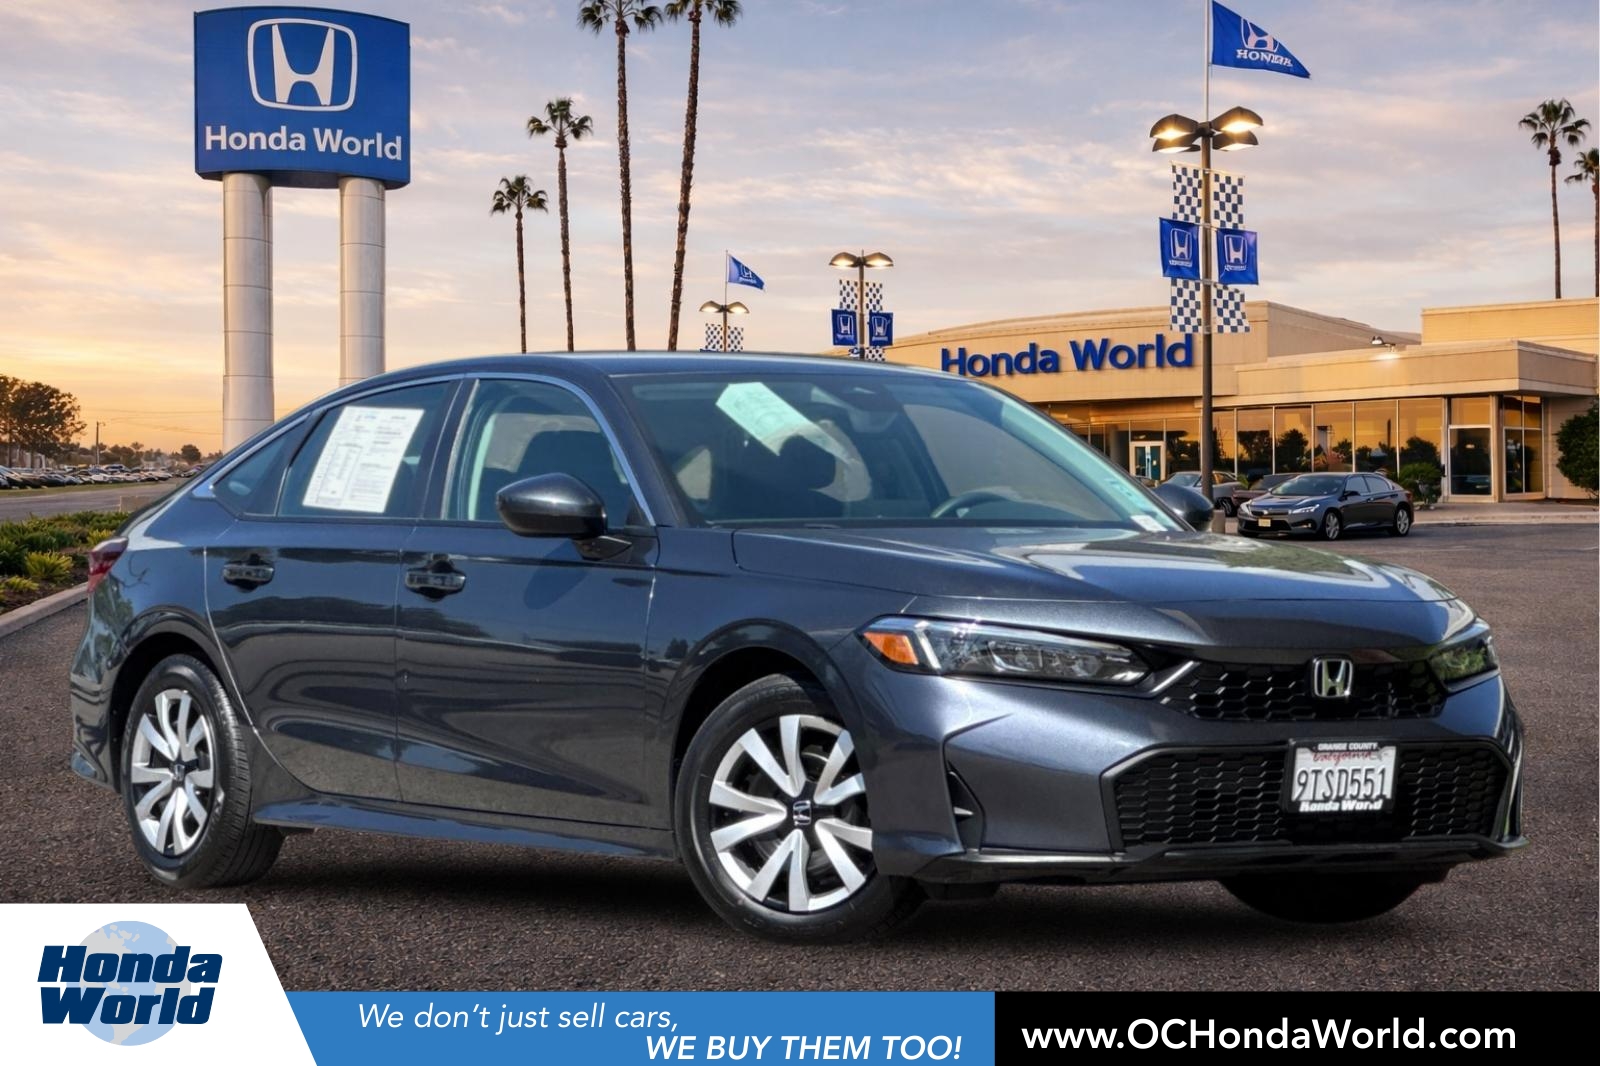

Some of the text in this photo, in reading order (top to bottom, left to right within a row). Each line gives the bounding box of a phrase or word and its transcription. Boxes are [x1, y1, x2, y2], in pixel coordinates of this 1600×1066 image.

[205, 125, 402, 161] Honda World
[941, 333, 1194, 377] Honda World
[1348, 742, 1378, 751] COUNTY
[1295, 767, 1387, 800] 9TSD551
[1299, 801, 1340, 812] Honda
